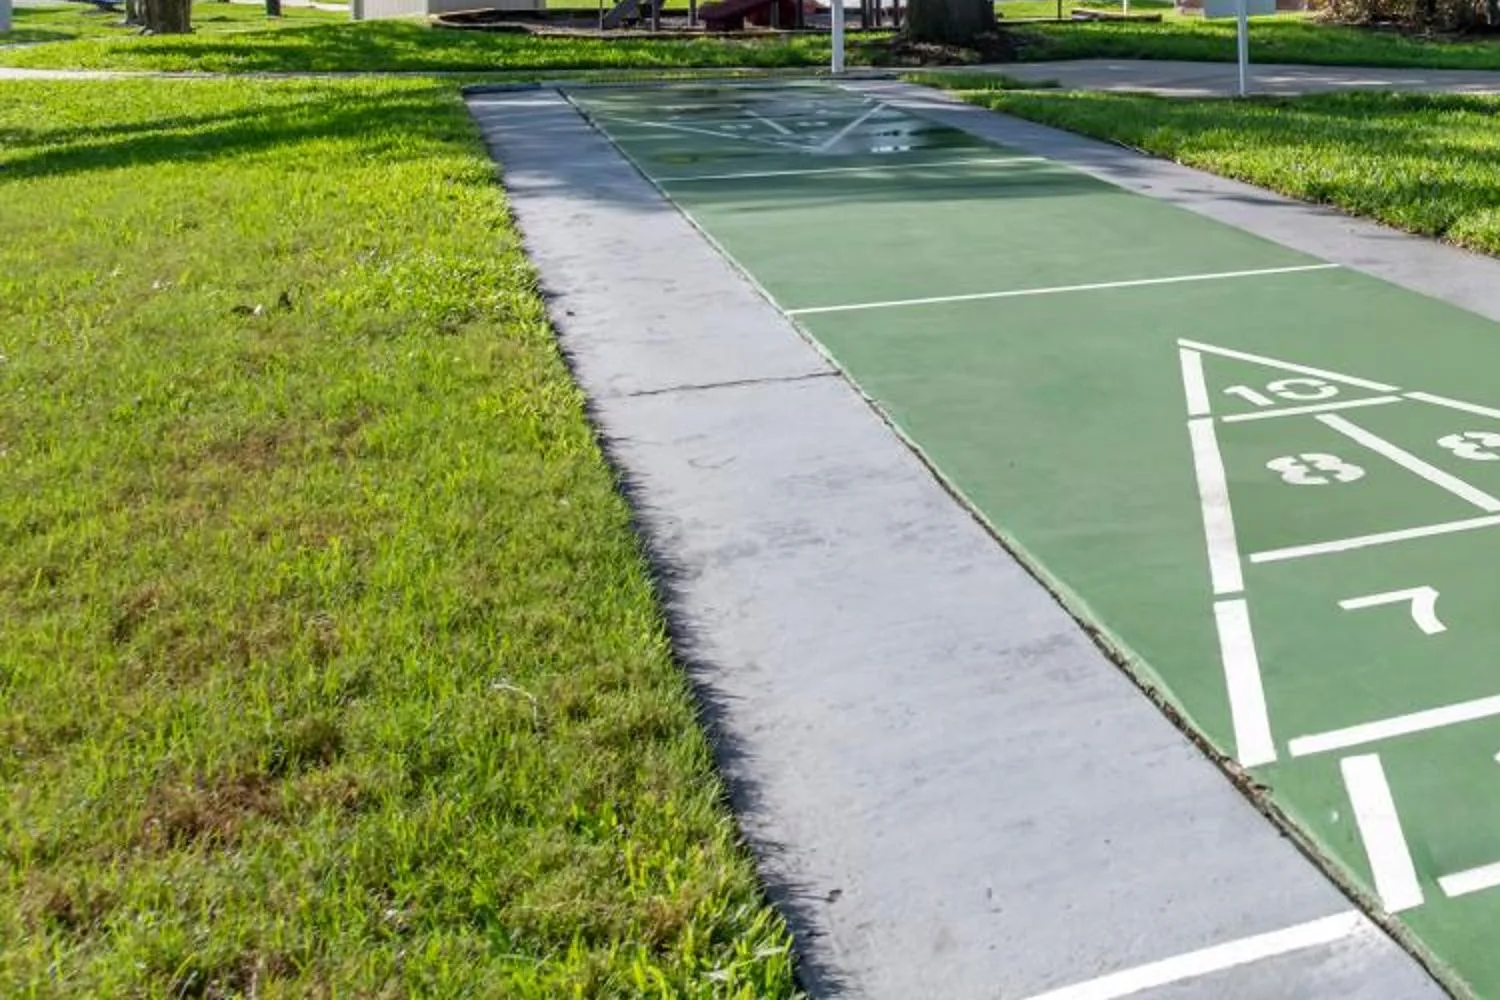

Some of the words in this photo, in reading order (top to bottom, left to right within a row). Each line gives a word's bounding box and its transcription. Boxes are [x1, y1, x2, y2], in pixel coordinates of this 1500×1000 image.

[1223, 376, 1341, 407] 10
[1265, 452, 1367, 486] 8
[1336, 585, 1449, 637] 7
